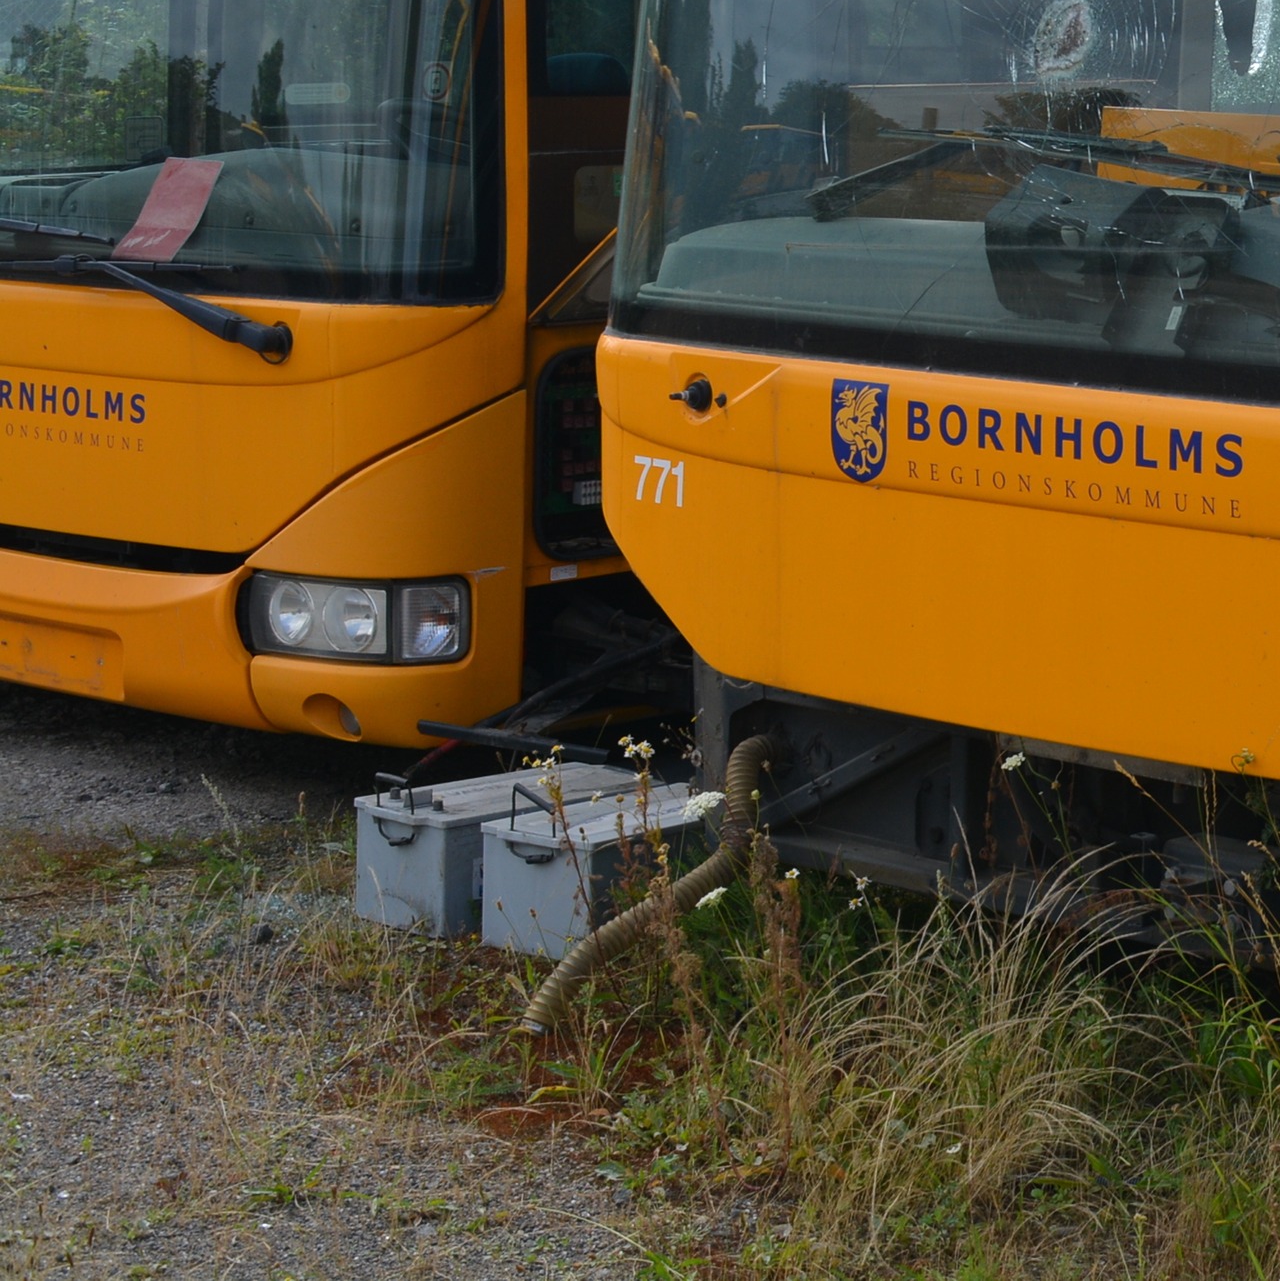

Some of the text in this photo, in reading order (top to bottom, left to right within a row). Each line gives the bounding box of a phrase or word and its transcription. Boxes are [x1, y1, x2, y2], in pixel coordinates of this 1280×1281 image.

[0, 380, 146, 424] RNHOLMS
[5, 423, 144, 452] ONSKOMMUNE
[907, 400, 1243, 477] BORNHOLMS
[634, 454, 684, 508] 771
[908, 461, 1241, 518] REGIONSKOMMUNE
